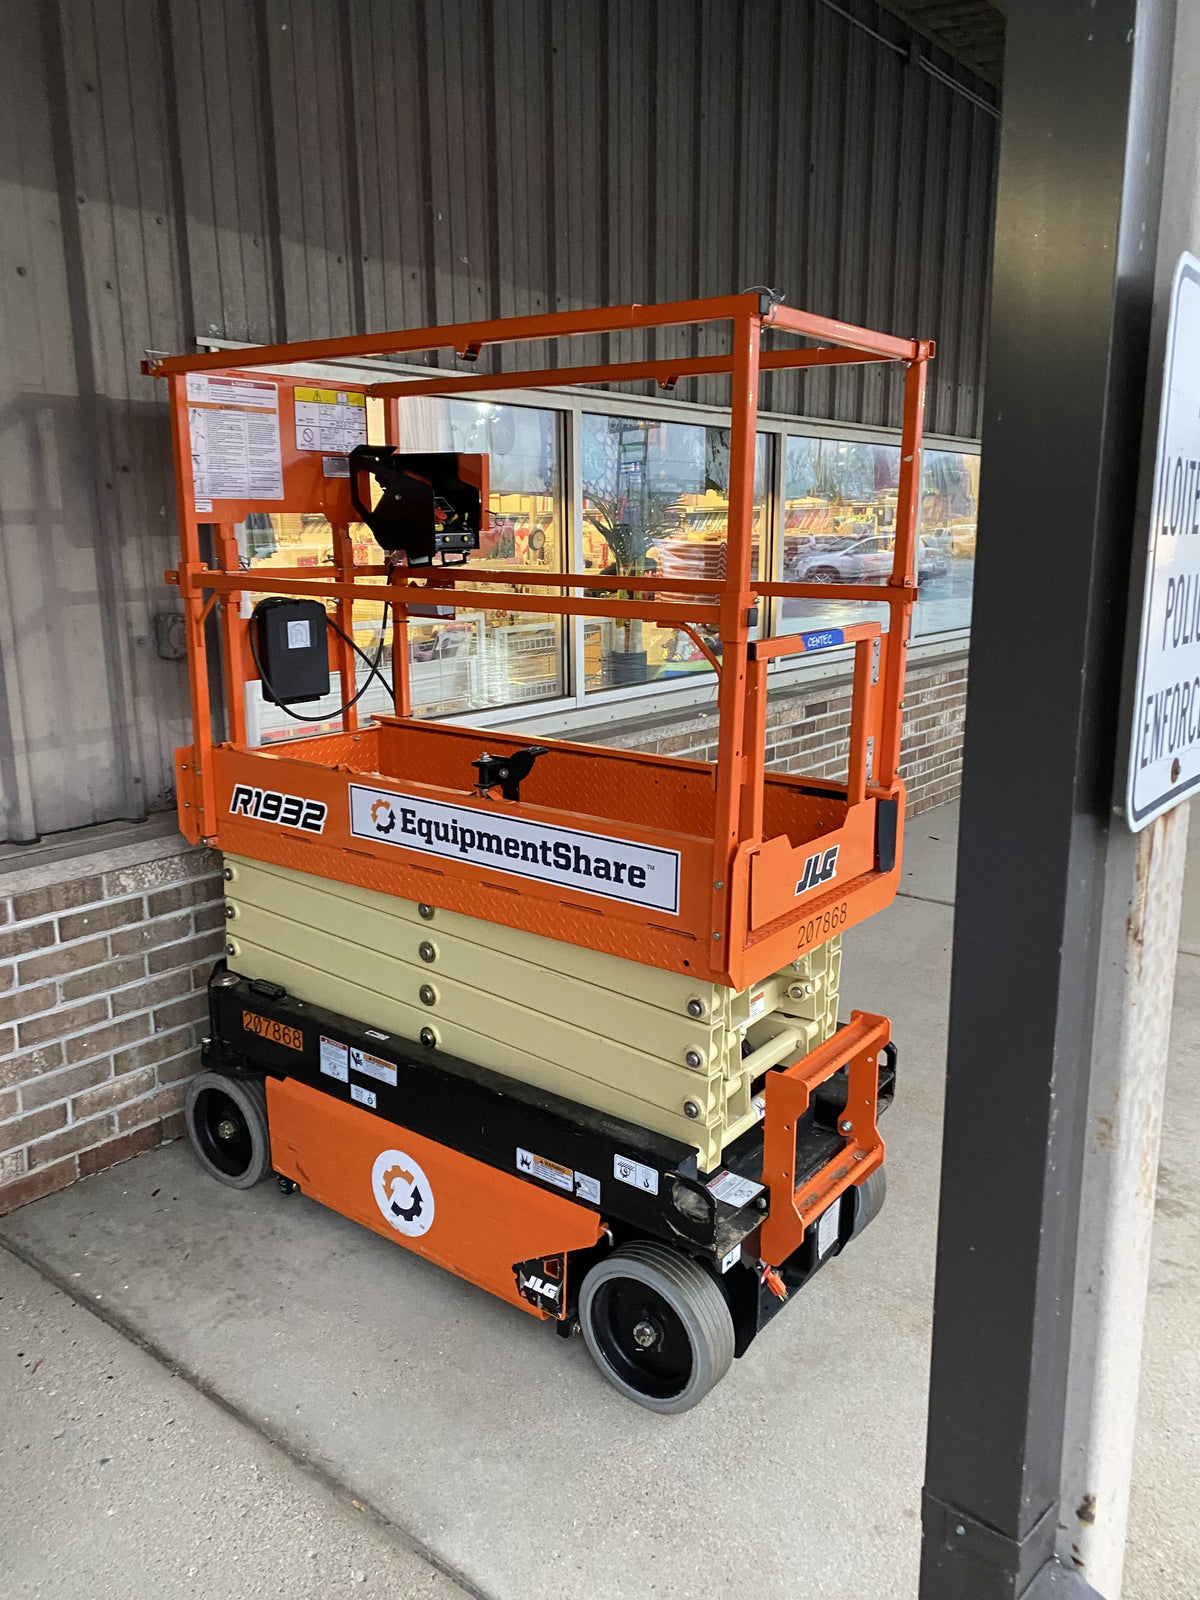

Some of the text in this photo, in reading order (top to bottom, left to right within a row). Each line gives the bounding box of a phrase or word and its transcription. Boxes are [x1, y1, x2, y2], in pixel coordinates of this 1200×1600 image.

[1141, 676, 1200, 770] ENFORC
[229, 783, 328, 834] R1932
[400, 807, 646, 889] EquipmentShare
[795, 845, 840, 896] JLG
[797, 902, 847, 949] 207868
[244, 1012, 301, 1048] 207868
[523, 1275, 559, 1299] JLG
